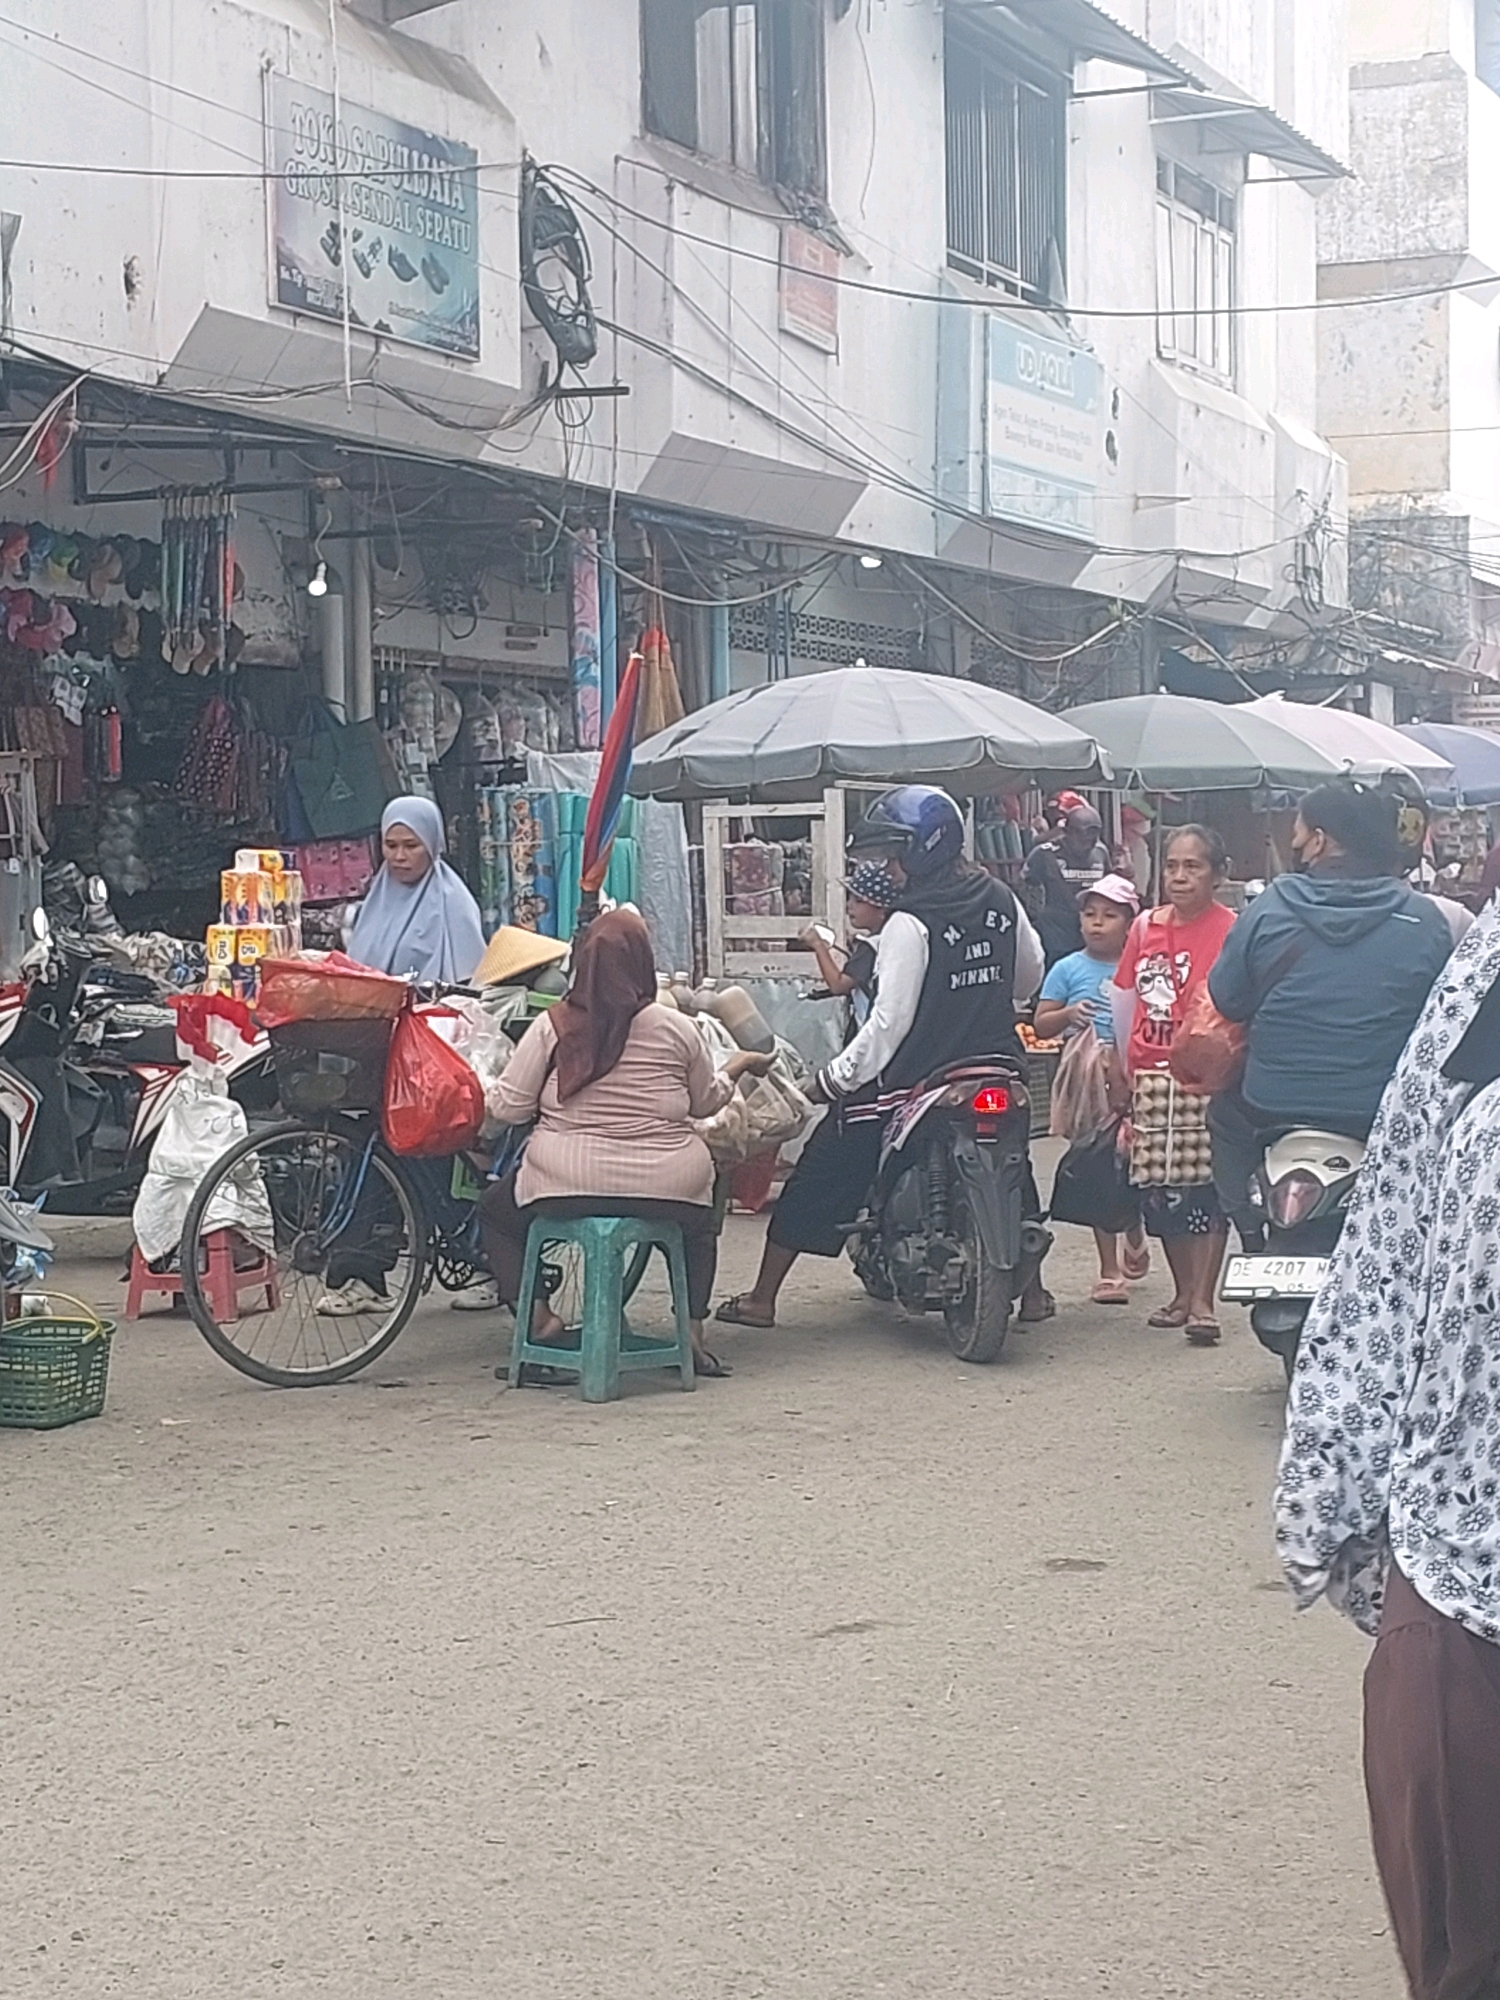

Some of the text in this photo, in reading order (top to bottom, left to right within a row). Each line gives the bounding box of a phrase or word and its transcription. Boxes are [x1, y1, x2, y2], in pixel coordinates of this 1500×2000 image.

[290, 101, 348, 170] TOKO
[352, 181, 413, 235] SENDAL
[416, 204, 472, 254] SEPATU
[965, 941, 991, 961] AND
[1233, 1261, 1253, 1277] DE
[1263, 1261, 1307, 1277] 4207
